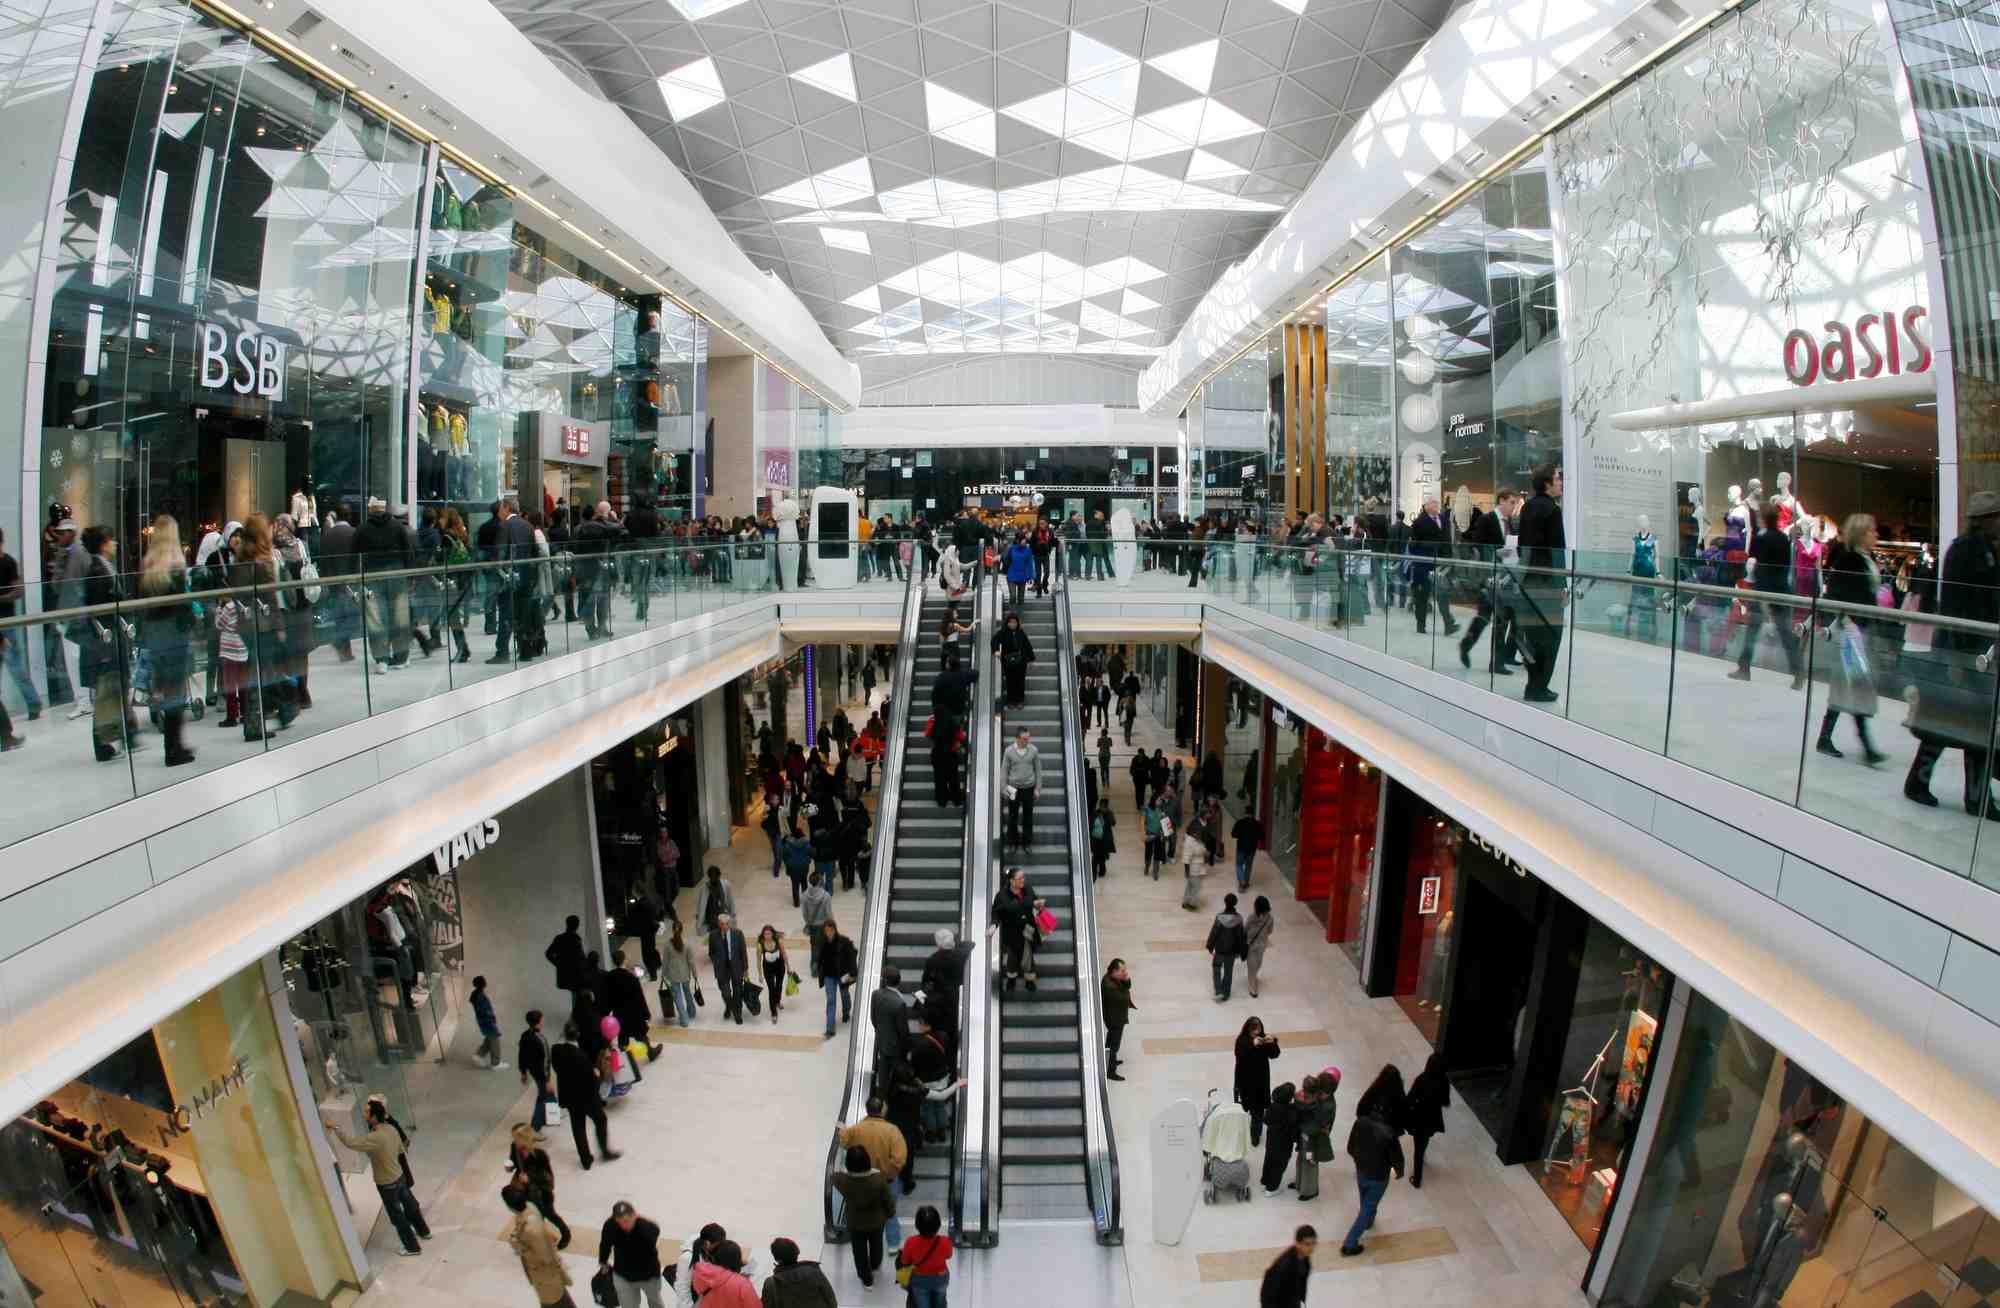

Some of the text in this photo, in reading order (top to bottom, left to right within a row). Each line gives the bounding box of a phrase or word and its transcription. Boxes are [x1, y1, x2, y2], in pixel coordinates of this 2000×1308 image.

[201, 323, 281, 397] BSB
[1455, 423, 1484, 438] norman
[432, 818, 500, 875] VANS
